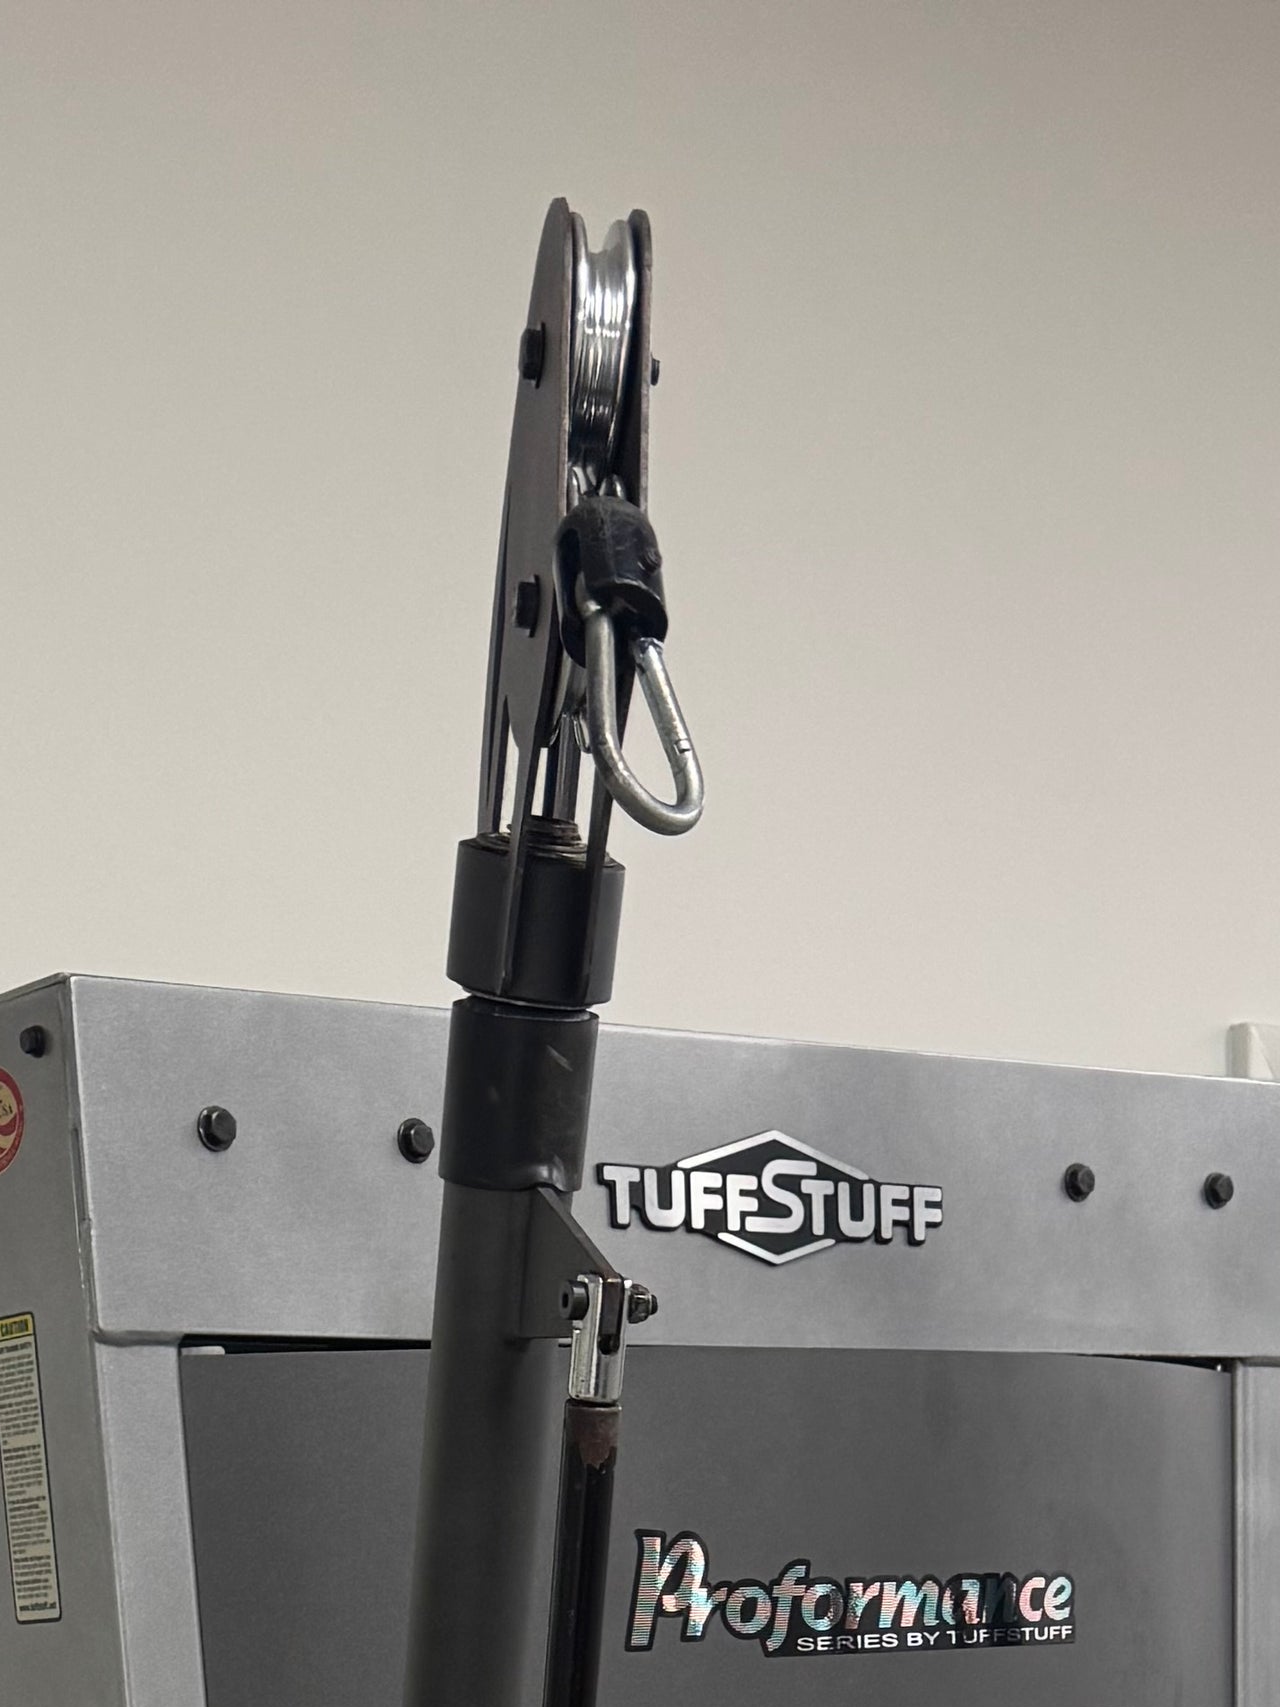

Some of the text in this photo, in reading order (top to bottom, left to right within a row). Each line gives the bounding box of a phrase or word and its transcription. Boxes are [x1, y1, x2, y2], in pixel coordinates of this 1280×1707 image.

[600, 1159, 942, 1242] TUFFSTUFF
[626, 1532, 1073, 1651] Proformance
[797, 1625, 1074, 1652] SERIES BY TUFFSTUFF
